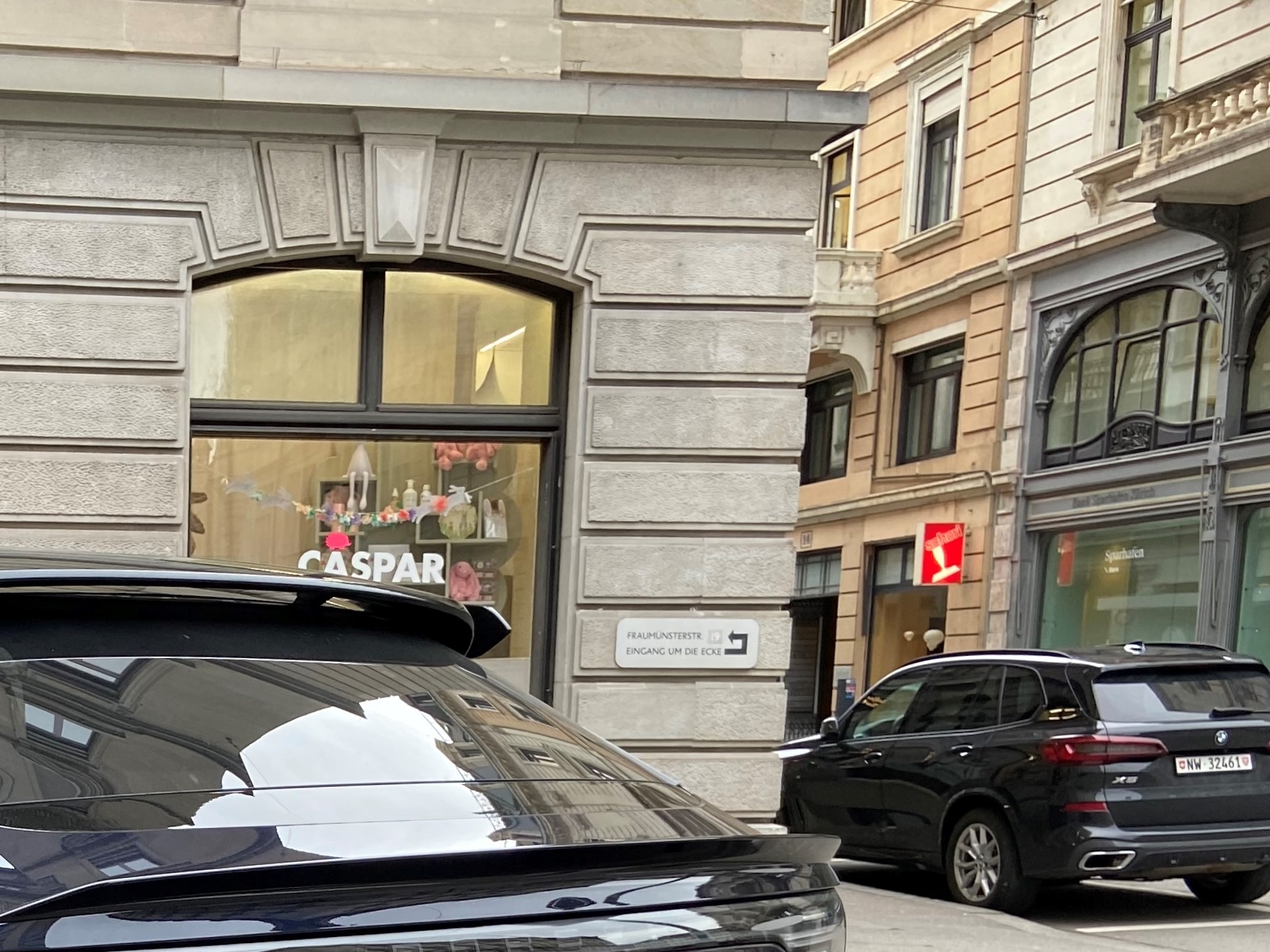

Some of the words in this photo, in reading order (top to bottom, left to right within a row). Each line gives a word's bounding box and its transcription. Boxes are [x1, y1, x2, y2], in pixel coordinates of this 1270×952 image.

[297, 550, 445, 584] CASPAR
[627, 630, 703, 640] FRAUMÜNSTERSTR.
[626, 647, 665, 655] EINGANG
[668, 647, 682, 655] UM
[685, 647, 698, 655] DIE
[701, 647, 722, 655] ECKE
[1111, 776, 1139, 784] X5
